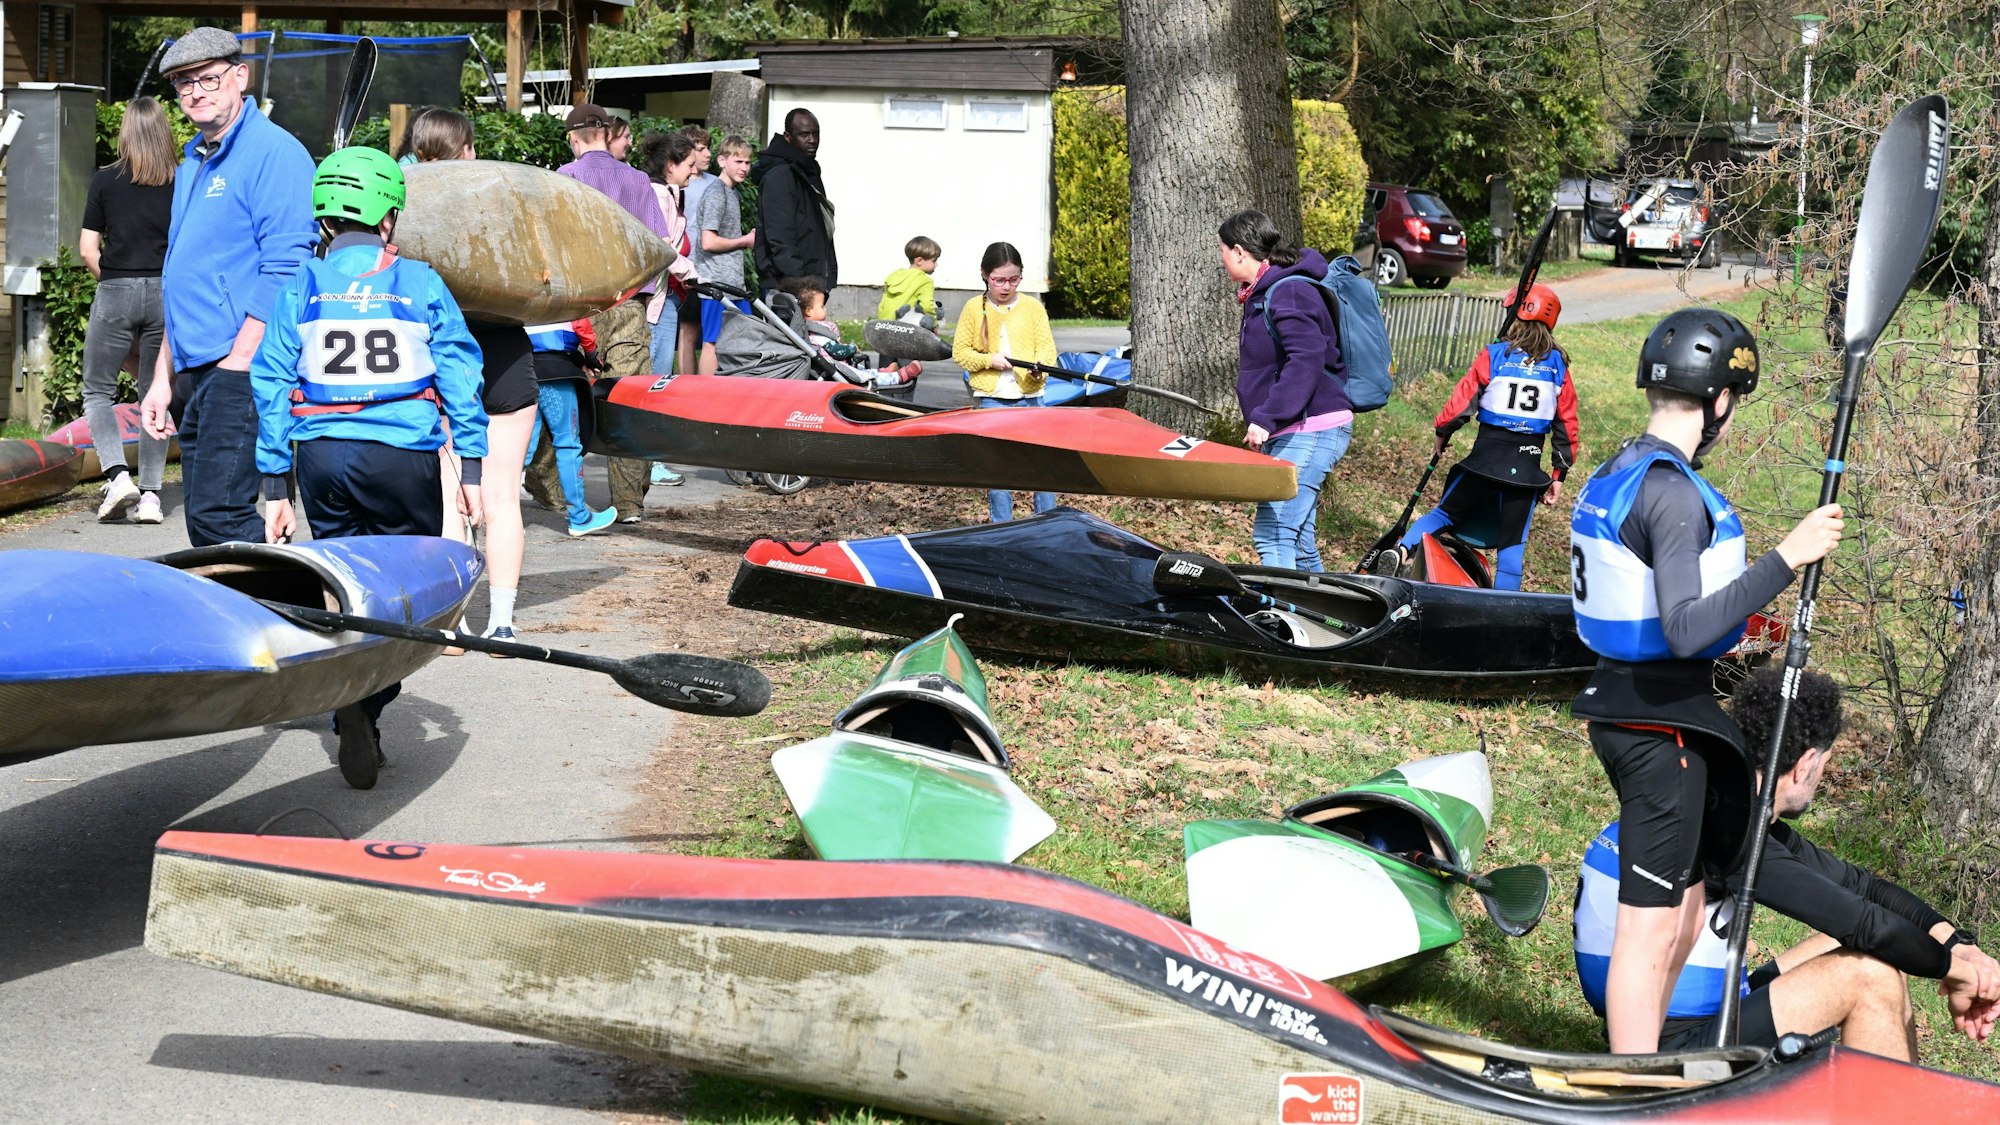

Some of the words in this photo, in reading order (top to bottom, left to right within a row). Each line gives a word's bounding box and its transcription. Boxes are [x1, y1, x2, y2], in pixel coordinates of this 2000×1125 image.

[322, 328, 400, 375] 28
[1507, 382, 1540, 412] 13
[693, 676, 724, 688] CARBON
[1265, 998, 1317, 1024] NEW
[1327, 1084, 1357, 1099] kick
[1333, 1097, 1357, 1111] the
[1310, 1111, 1357, 1122] waves
